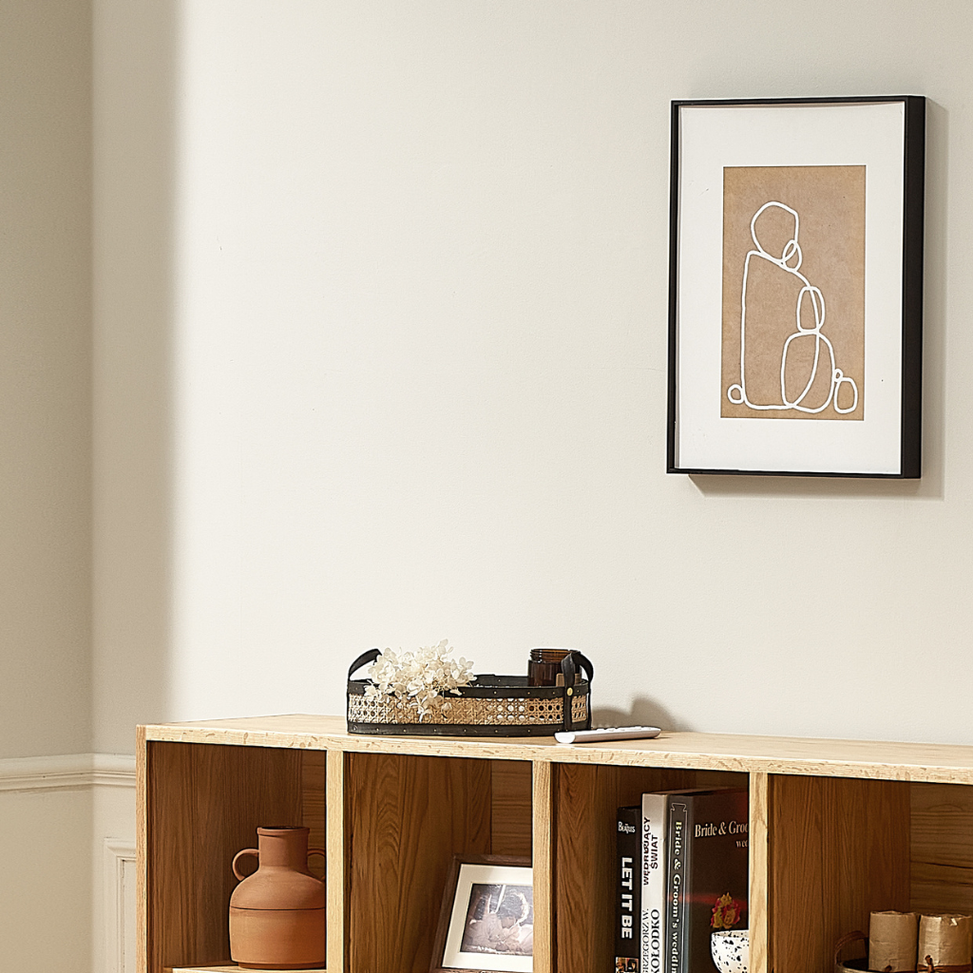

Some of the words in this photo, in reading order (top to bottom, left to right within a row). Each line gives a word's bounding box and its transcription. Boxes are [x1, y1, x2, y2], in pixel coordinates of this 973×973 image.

[675, 821, 683, 855] Bride
[694, 823, 717, 838] Bride
[718, 821, 727, 836] &
[650, 835, 659, 869] ŚWIAT
[673, 858, 682, 870] &
[621, 857, 633, 891] LET
[621, 895, 633, 912] IT
[672, 874, 681, 929] Groom's
[621, 915, 633, 939] BE
